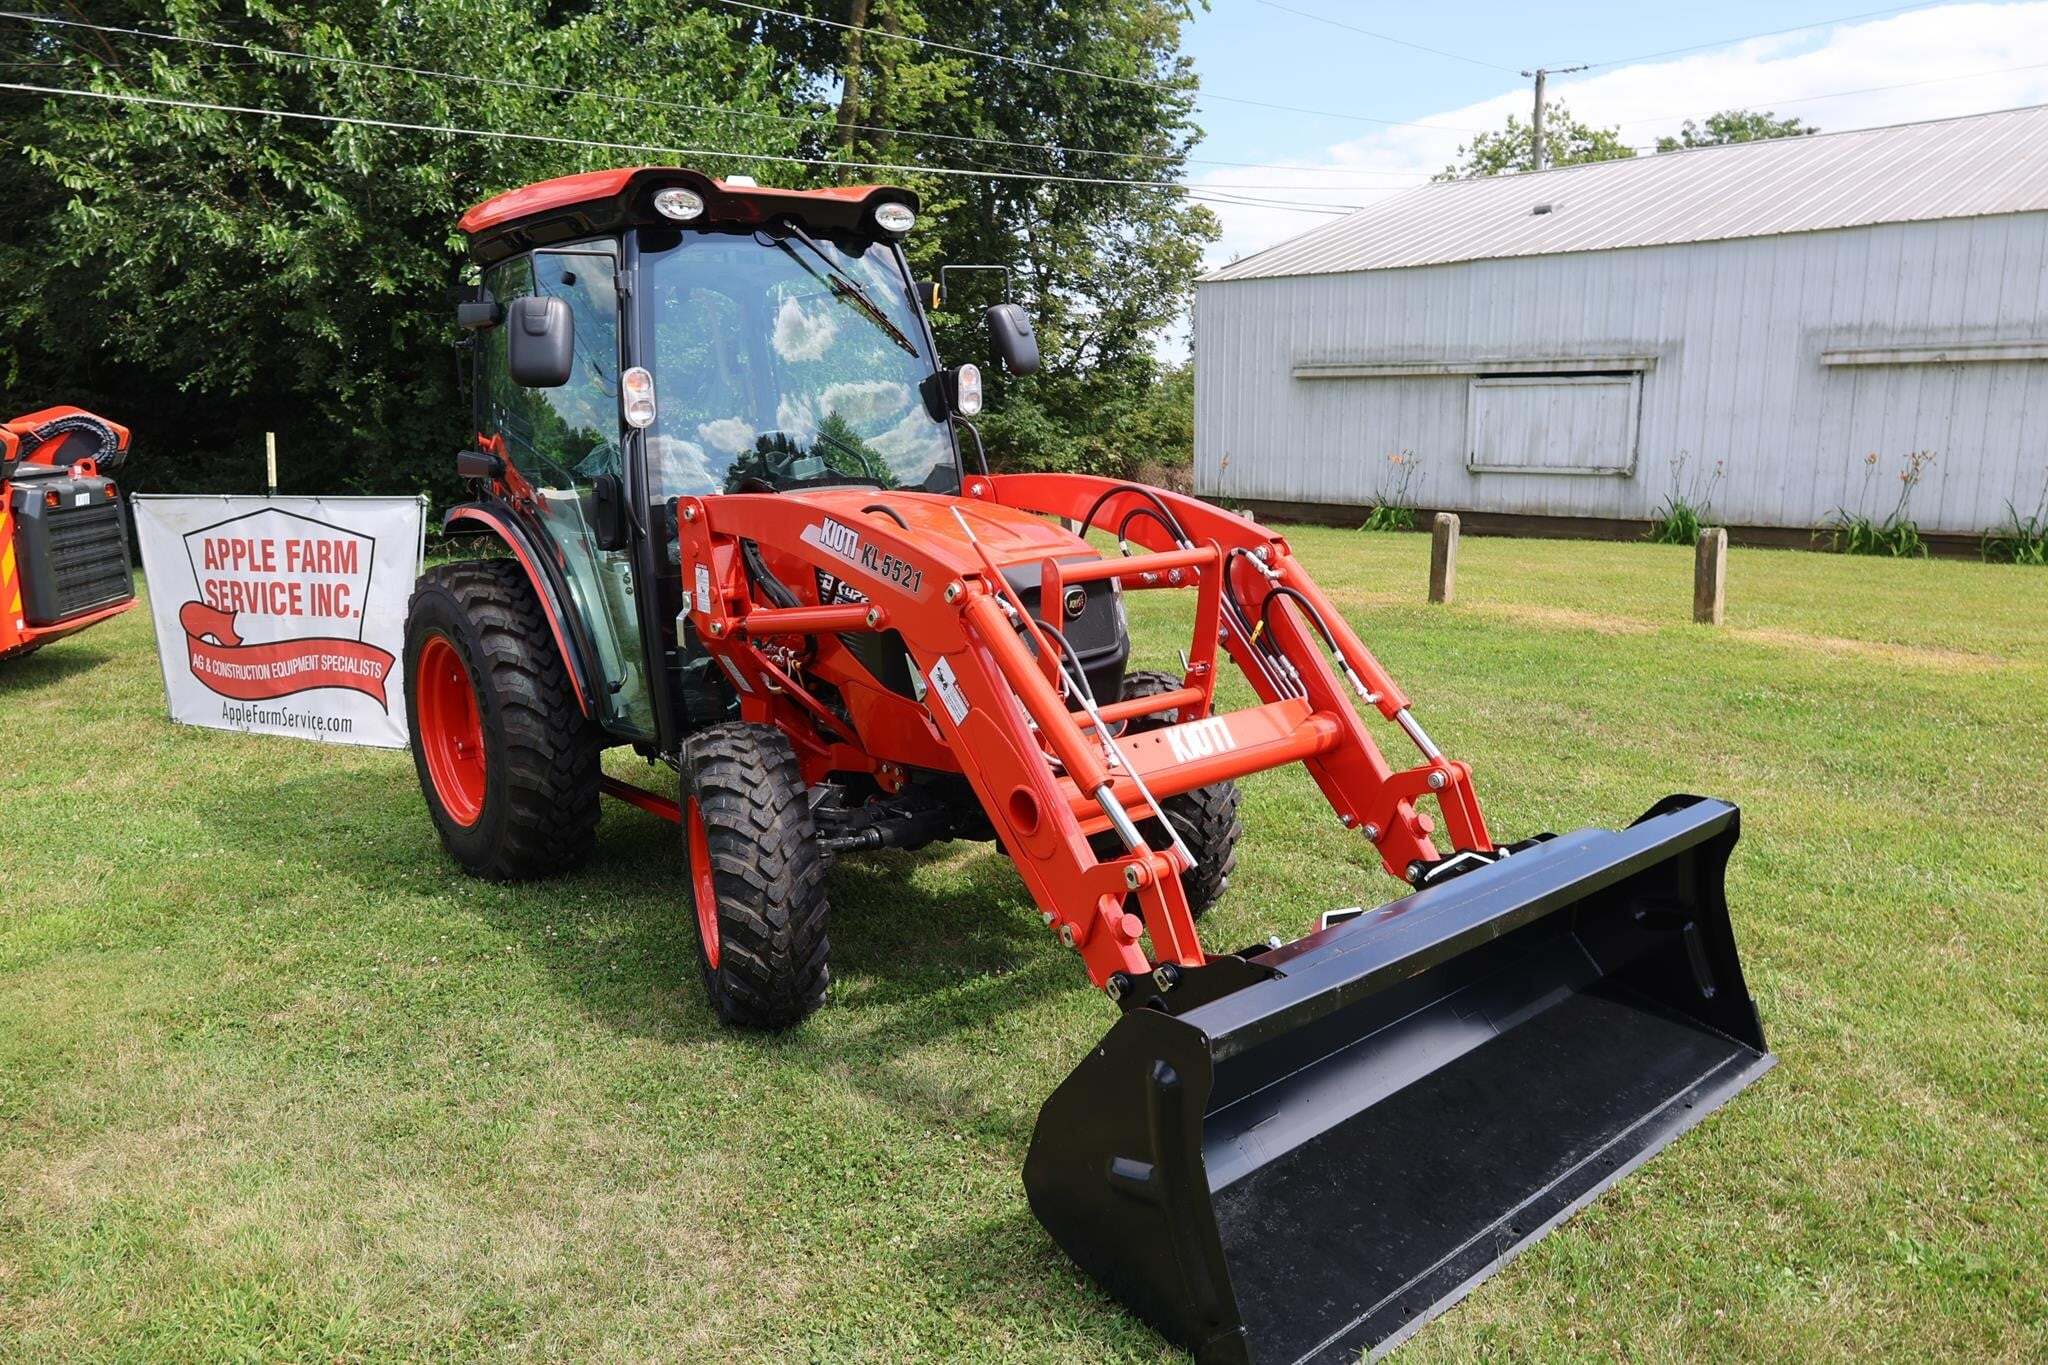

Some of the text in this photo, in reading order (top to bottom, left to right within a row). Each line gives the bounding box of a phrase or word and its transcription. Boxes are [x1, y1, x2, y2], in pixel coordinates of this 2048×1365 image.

[204, 538, 358, 574] APPLE FARM
[819, 515, 860, 561] KIOTI
[204, 578, 360, 619] SERVICE INC.
[192, 653, 383, 680] AG & CONSTRUCTION EQUIPMENT SPECIALISTS
[222, 701, 353, 733] AppleFarmService.com
[1163, 717, 1237, 762] KIOTI
